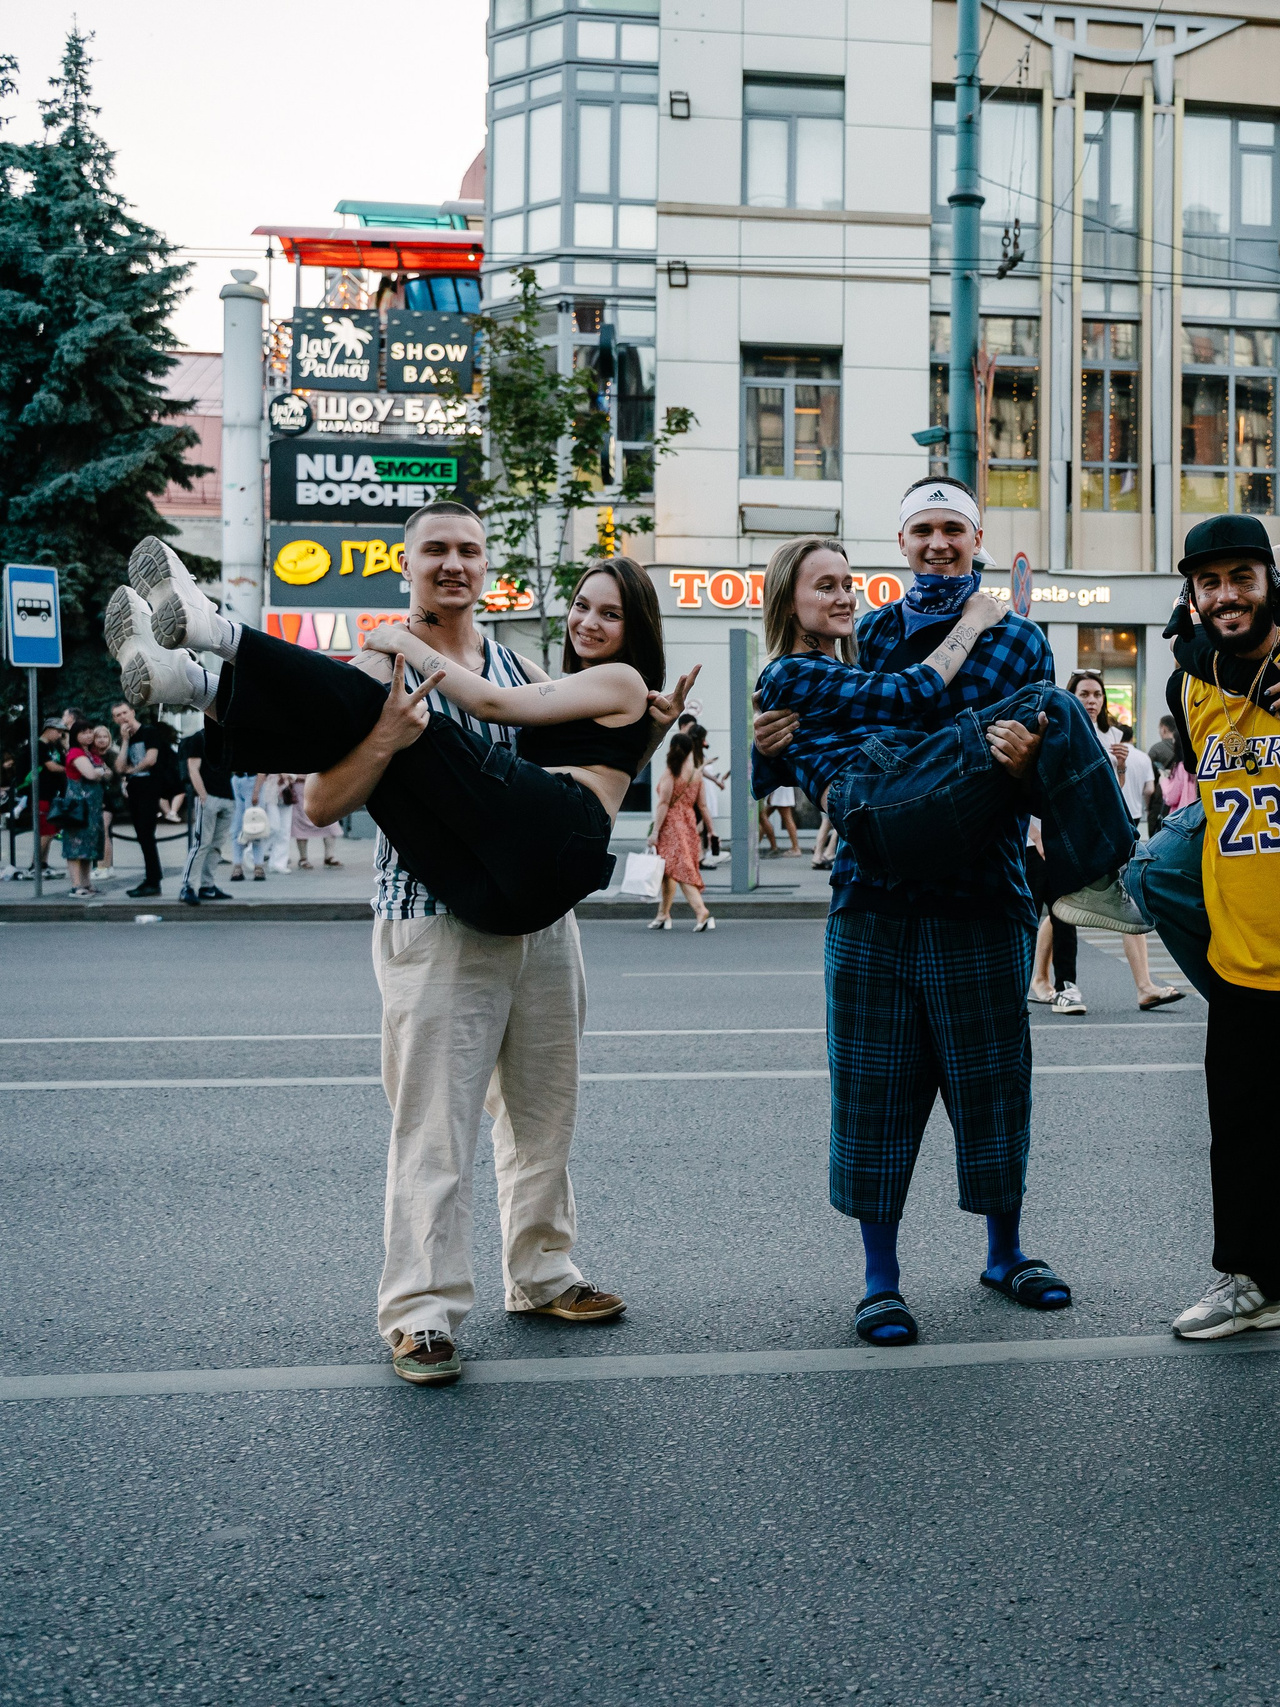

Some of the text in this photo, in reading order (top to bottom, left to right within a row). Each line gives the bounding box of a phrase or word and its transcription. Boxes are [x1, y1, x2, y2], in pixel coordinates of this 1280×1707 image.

[390, 341, 468, 362] SHOW
[299, 358, 370, 382] Palmas
[317, 396, 467, 423] ШОУ-БАР
[316, 420, 380, 434] КАРАОКЕ
[296, 453, 381, 482] NUA
[375, 461, 452, 478] SMOKE
[1077, 586, 1111, 607] grill
